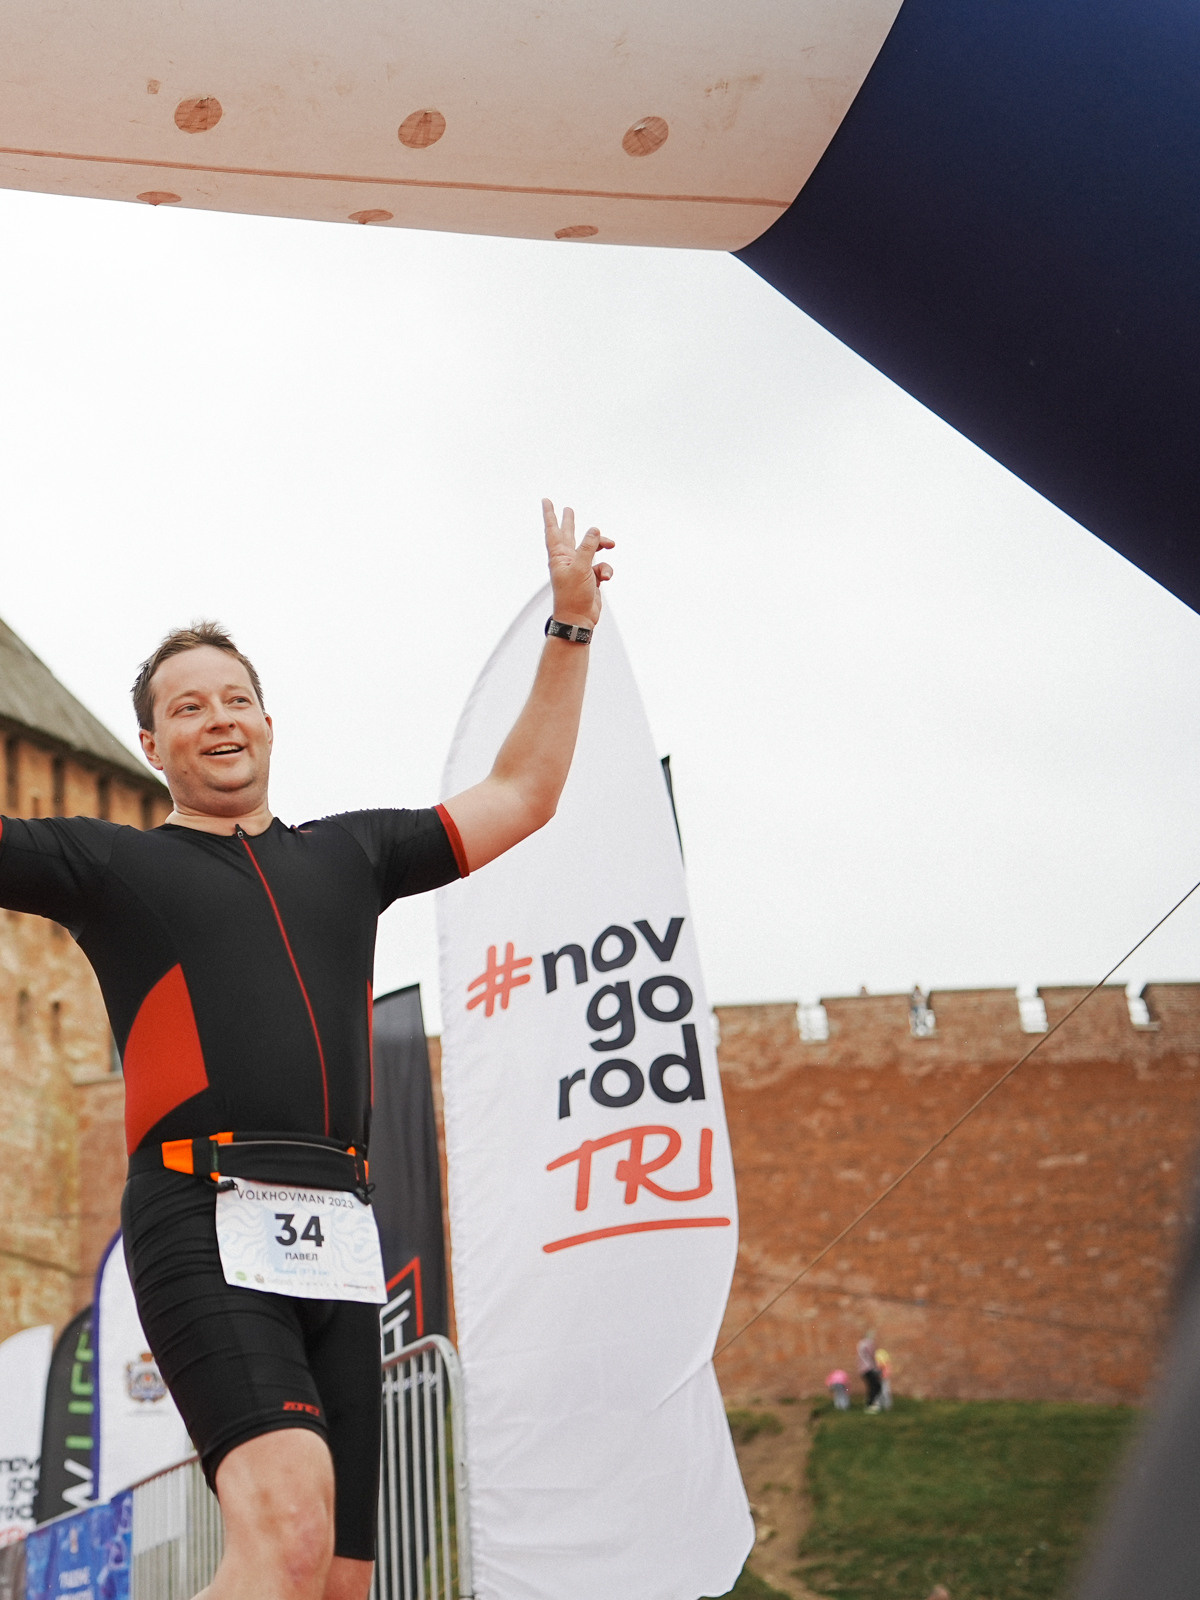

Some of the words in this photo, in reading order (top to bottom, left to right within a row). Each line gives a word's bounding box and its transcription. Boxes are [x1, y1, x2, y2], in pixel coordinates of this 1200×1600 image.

[466, 917, 685, 1017] #nov
[586, 975, 693, 1051] go
[558, 1023, 706, 1120] rod
[237, 1189, 325, 1205] VOLKHOVMAN
[329, 1197, 355, 1210] 2023
[546, 1125, 713, 1211] TRI
[274, 1213, 325, 1247] 34
[285, 1252, 318, 1262] ПАВЕЛ
